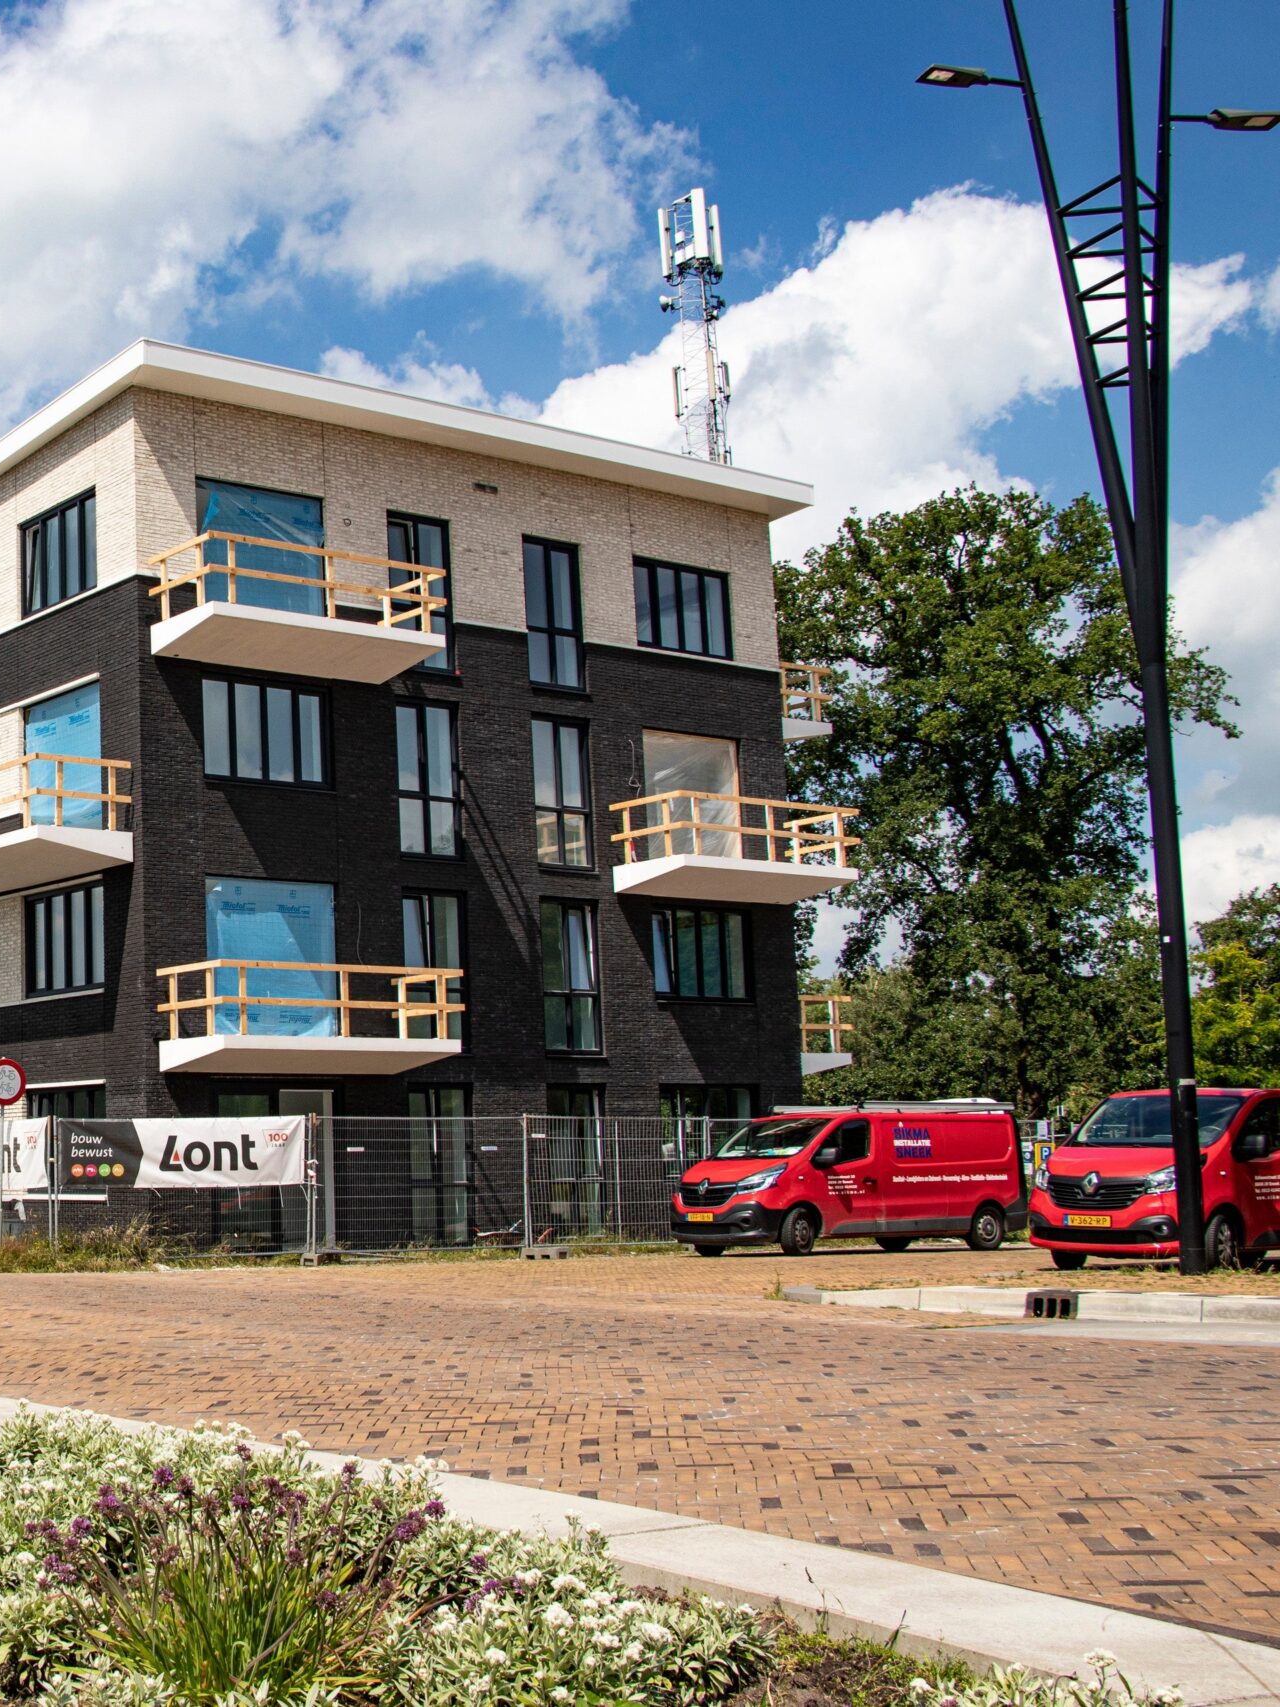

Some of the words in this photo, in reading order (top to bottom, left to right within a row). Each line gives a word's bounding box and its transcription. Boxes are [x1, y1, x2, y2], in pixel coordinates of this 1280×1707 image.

[70, 1132, 103, 1145] bouw
[268, 1132, 289, 1142] 100
[893, 1127, 931, 1140] SIKMA
[893, 1139, 932, 1147] INSTALLATIE
[71, 1145, 113, 1158] bewust
[158, 1133, 259, 1172] Lont
[895, 1146, 933, 1159] SNEEK
[1042, 1147, 1050, 1160] P
[1070, 1216, 1108, 1225] V-362-RP
